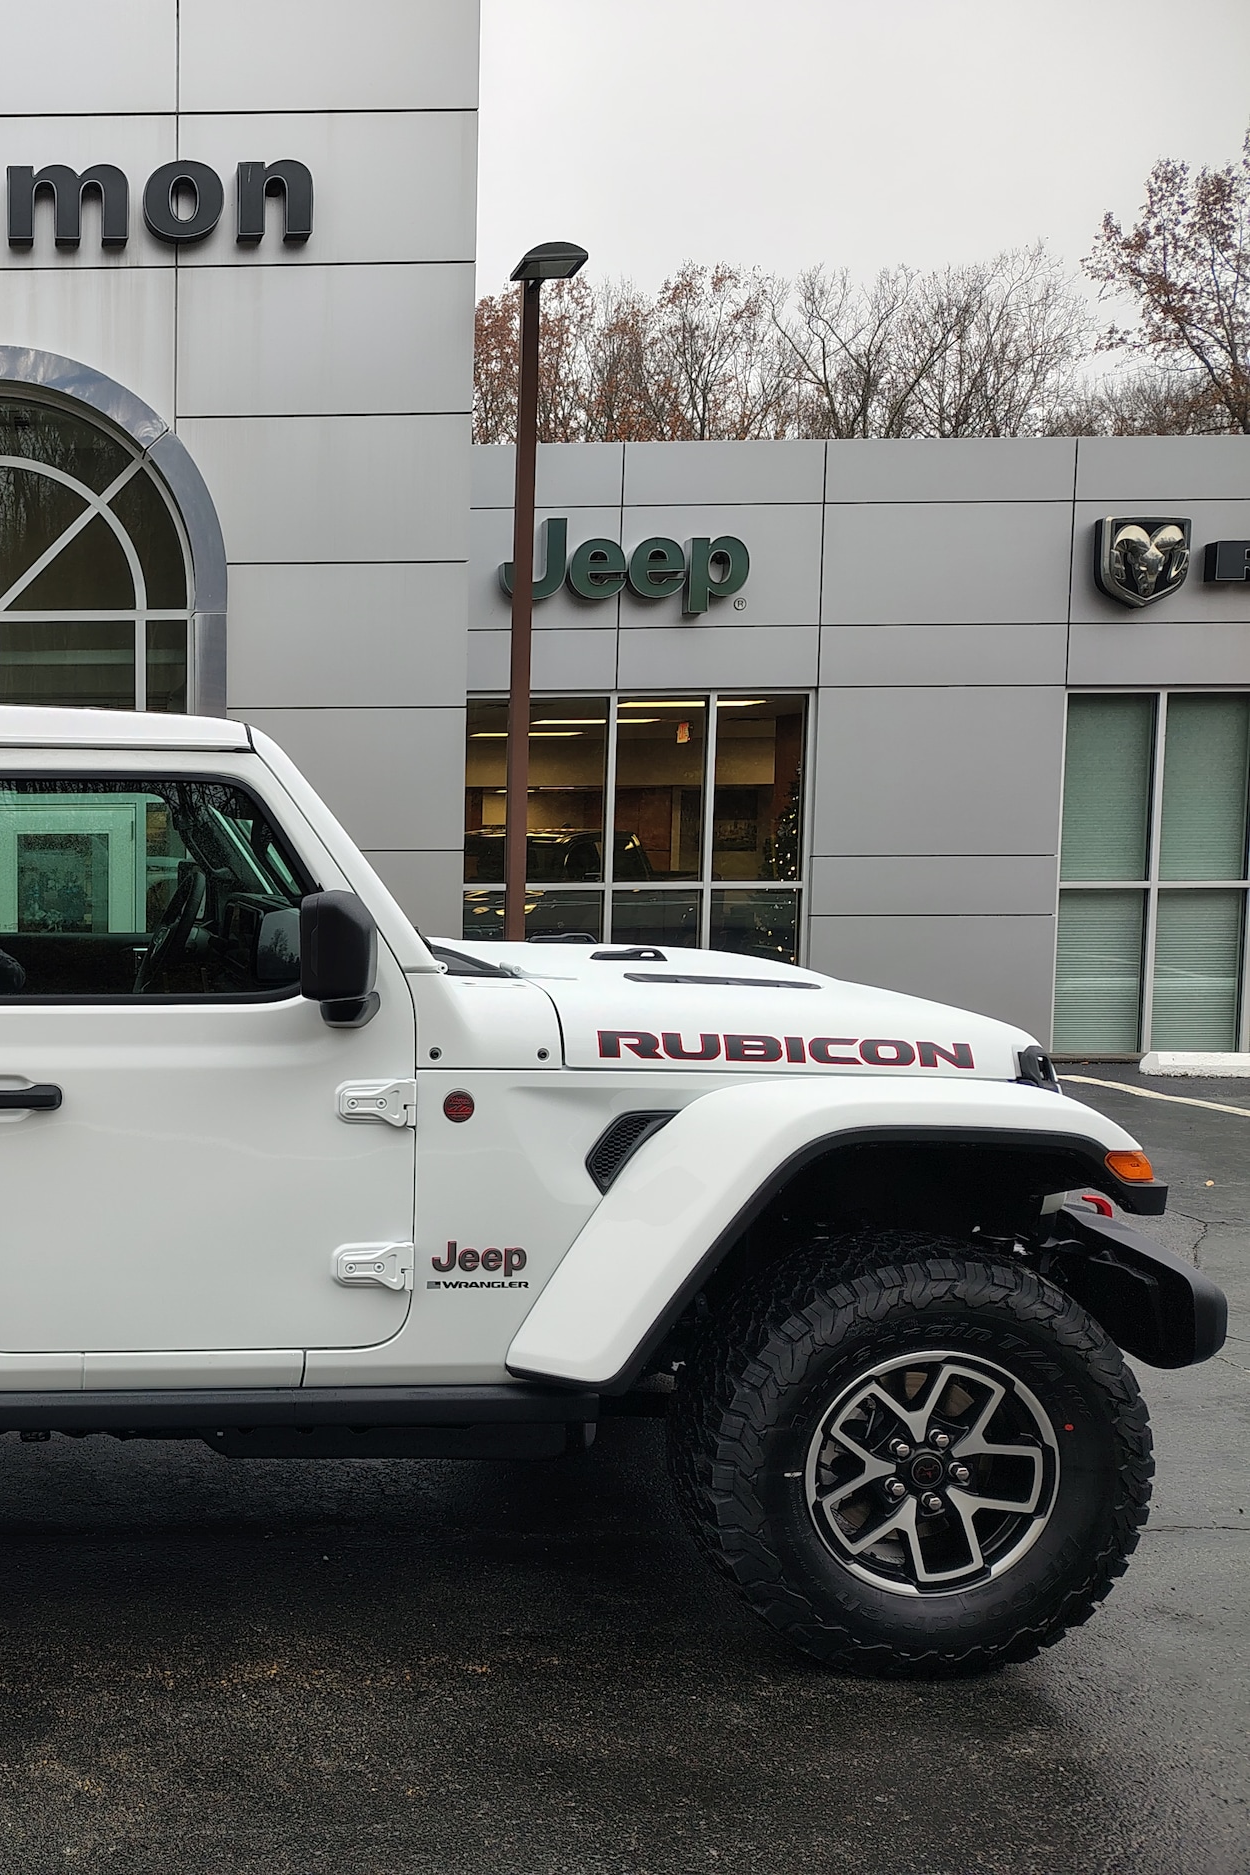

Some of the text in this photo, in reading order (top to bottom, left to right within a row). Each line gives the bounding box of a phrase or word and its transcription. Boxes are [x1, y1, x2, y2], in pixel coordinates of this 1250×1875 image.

[499, 517, 750, 616] Jeep
[596, 1030, 975, 1069] RUBICON
[431, 1240, 528, 1277] Jeep
[442, 1281, 529, 1289] WRANGLER
